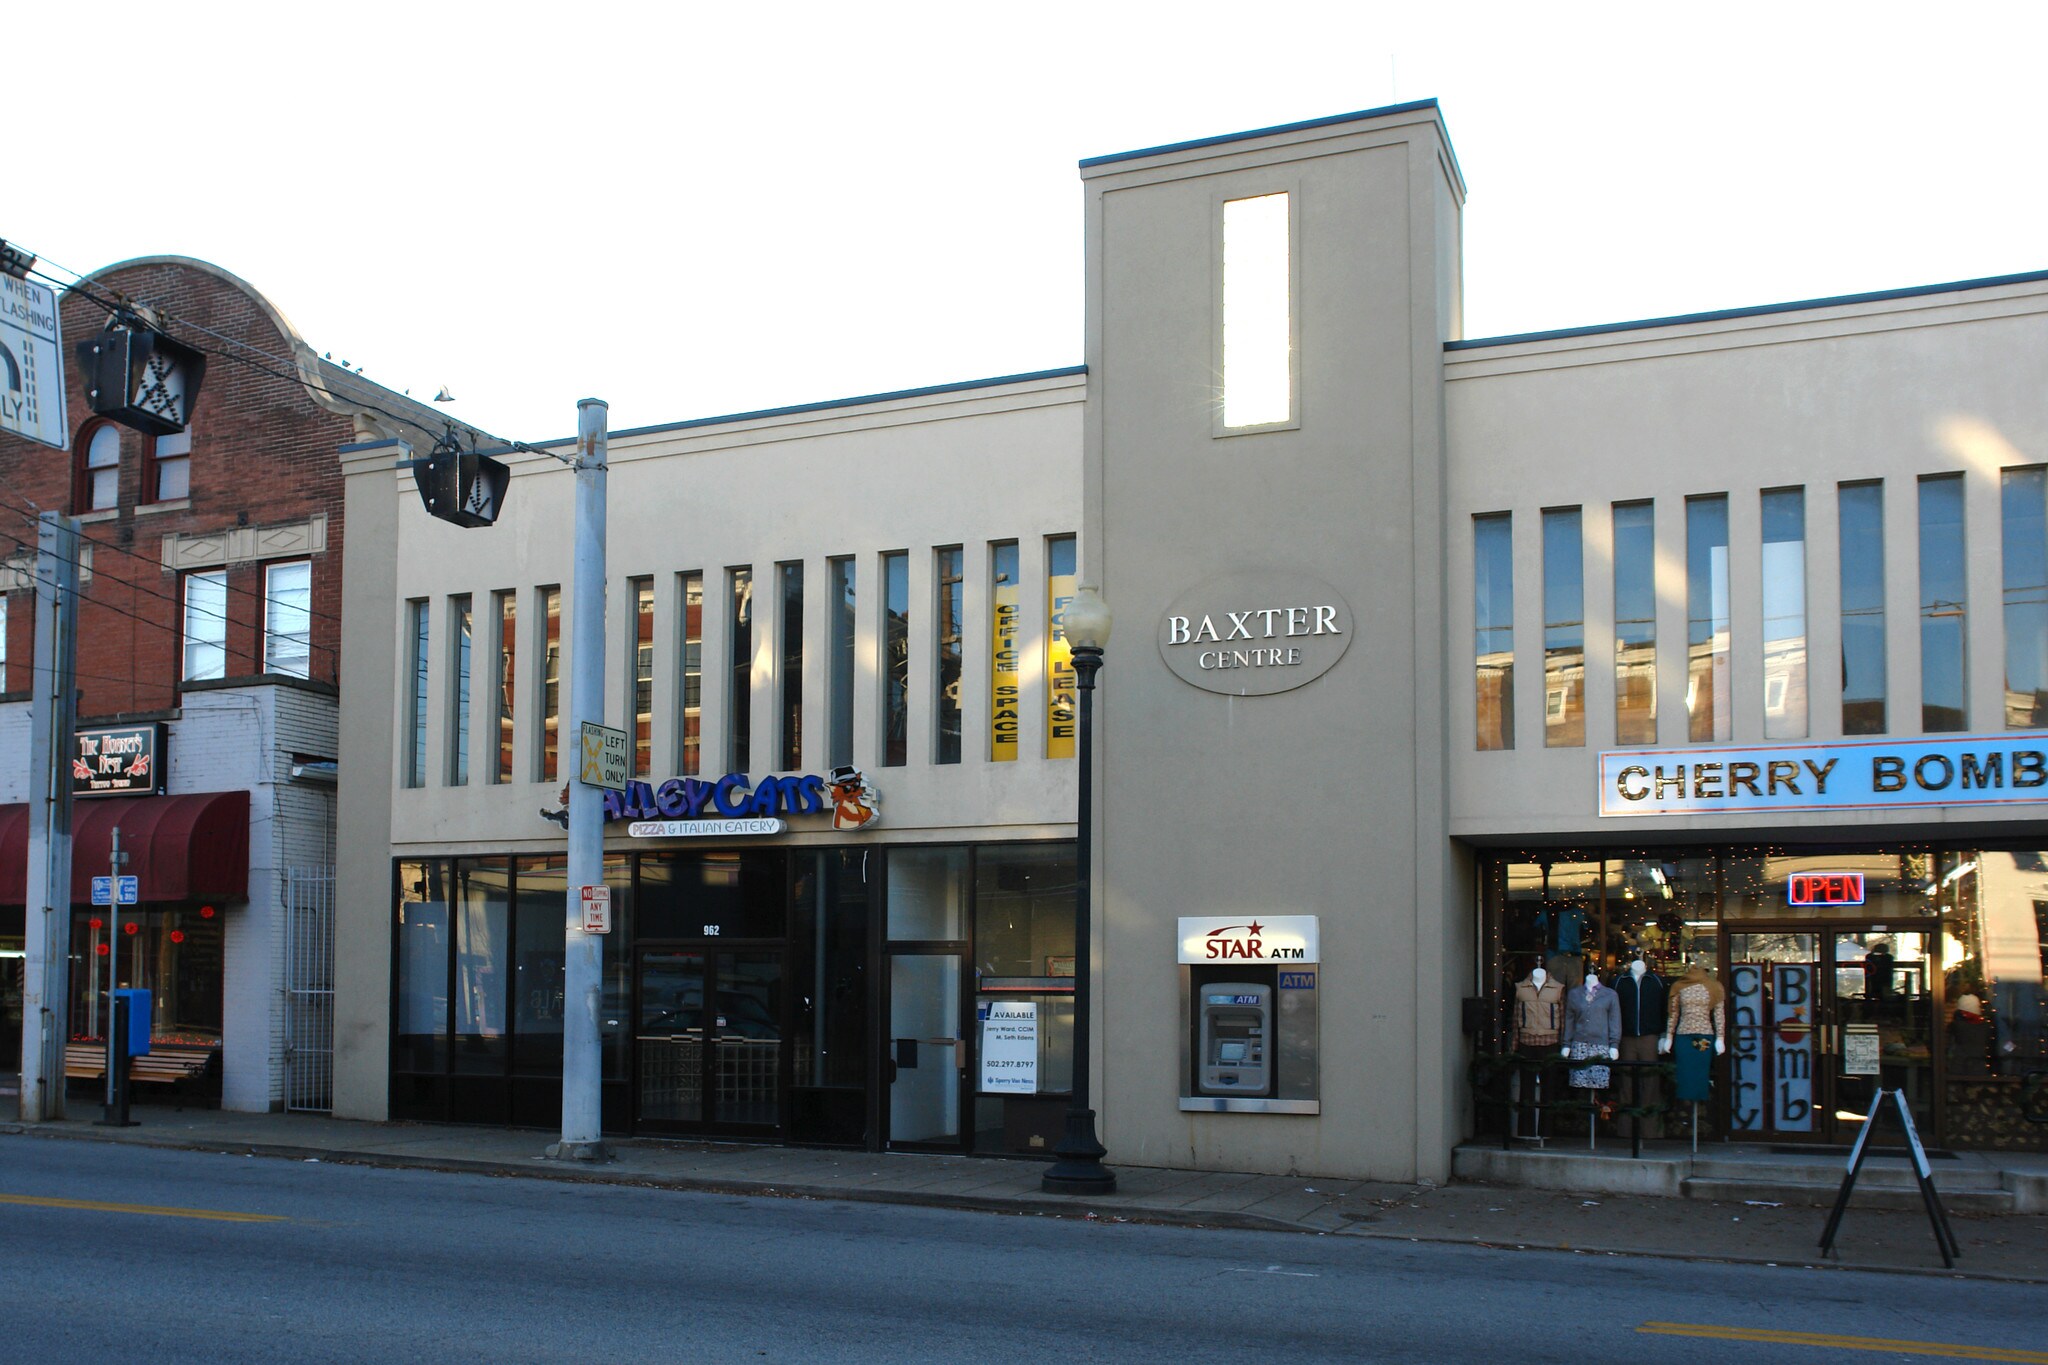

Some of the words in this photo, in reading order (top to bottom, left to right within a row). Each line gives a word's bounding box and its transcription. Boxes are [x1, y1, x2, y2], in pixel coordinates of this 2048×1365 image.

[3, 275, 41, 305] WHEN
[0, 296, 54, 332] LASHING
[1168, 605, 1342, 645] BAXTER
[996, 604, 1019, 672] OFFICE
[1199, 648, 1303, 670] CENTRE
[1051, 662, 1076, 738] LEASE
[994, 685, 1018, 743] SPACE
[605, 735, 625, 750] LEFT
[605, 752, 626, 767] TURN
[605, 769, 624, 783] ONLY
[1617, 758, 1839, 801] CHERRY
[1872, 751, 2048, 793] BOMB
[632, 823, 666, 835] PIZZA
[668, 823, 676, 834] &
[679, 822, 722, 834] ITALIAN
[724, 820, 776, 833] EATERY
[583, 889, 592, 898] NO
[1792, 875, 1862, 903] OPEN
[590, 902, 602, 911] ANY
[590, 913, 603, 922] TIME
[703, 925, 720, 936] 962
[1206, 938, 1264, 959] STAR
[1270, 948, 1304, 959] ATM
[1281, 974, 1314, 987] ATM
[1236, 995, 1257, 1004] ATM
[994, 1011, 1034, 1019] AVAILABLE
